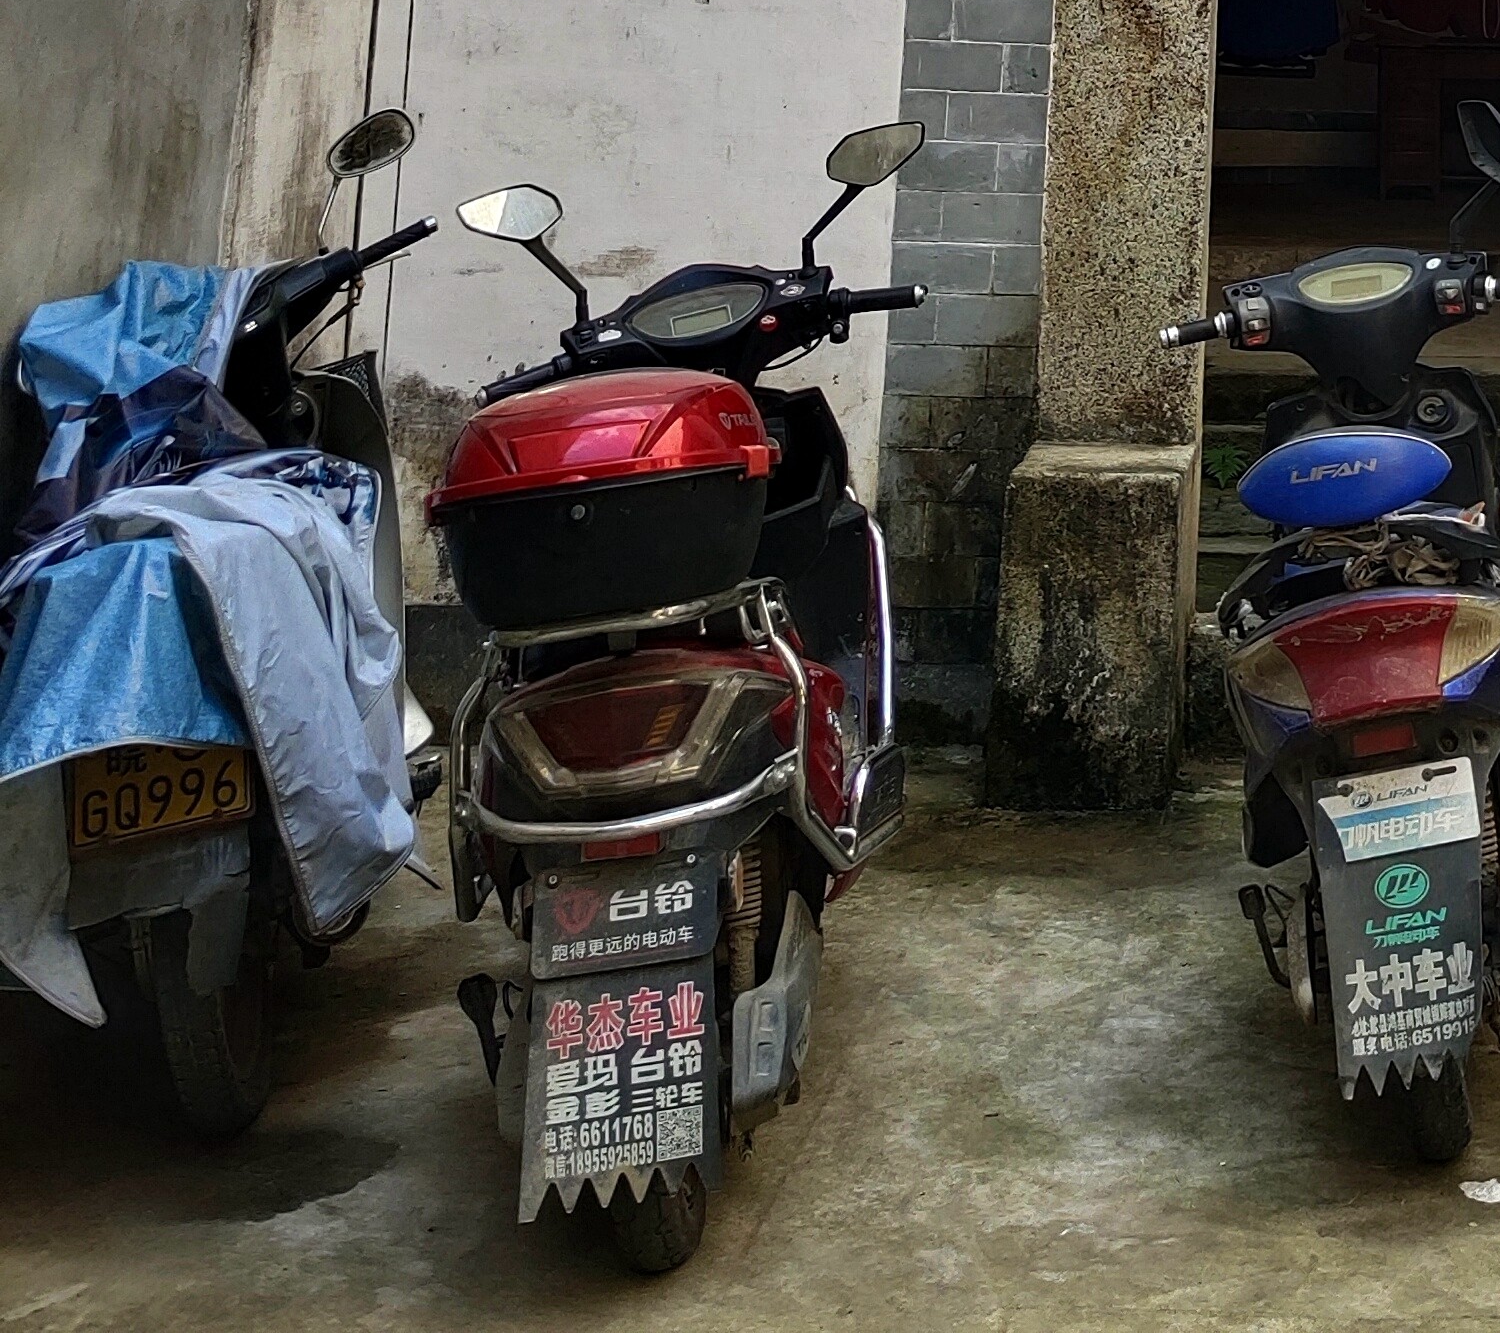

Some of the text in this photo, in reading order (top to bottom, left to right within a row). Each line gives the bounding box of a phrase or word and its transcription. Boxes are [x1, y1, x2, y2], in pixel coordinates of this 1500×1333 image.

[1289, 457, 1378, 485] LIFAN
[81, 759, 238, 840] GQ996
[1376, 784, 1428, 802] LIFAN
[608, 879, 695, 922] 台铃
[1365, 906, 1447, 935] LIFAN
[550, 925, 695, 964] 跑得更远的电动车
[1345, 941, 1475, 1014] 大中车业
[545, 980, 705, 1060] 华杰车业
[546, 1039, 703, 1098] 爱玛 台铃
[545, 1081, 703, 1125] 金彭 三轮车
